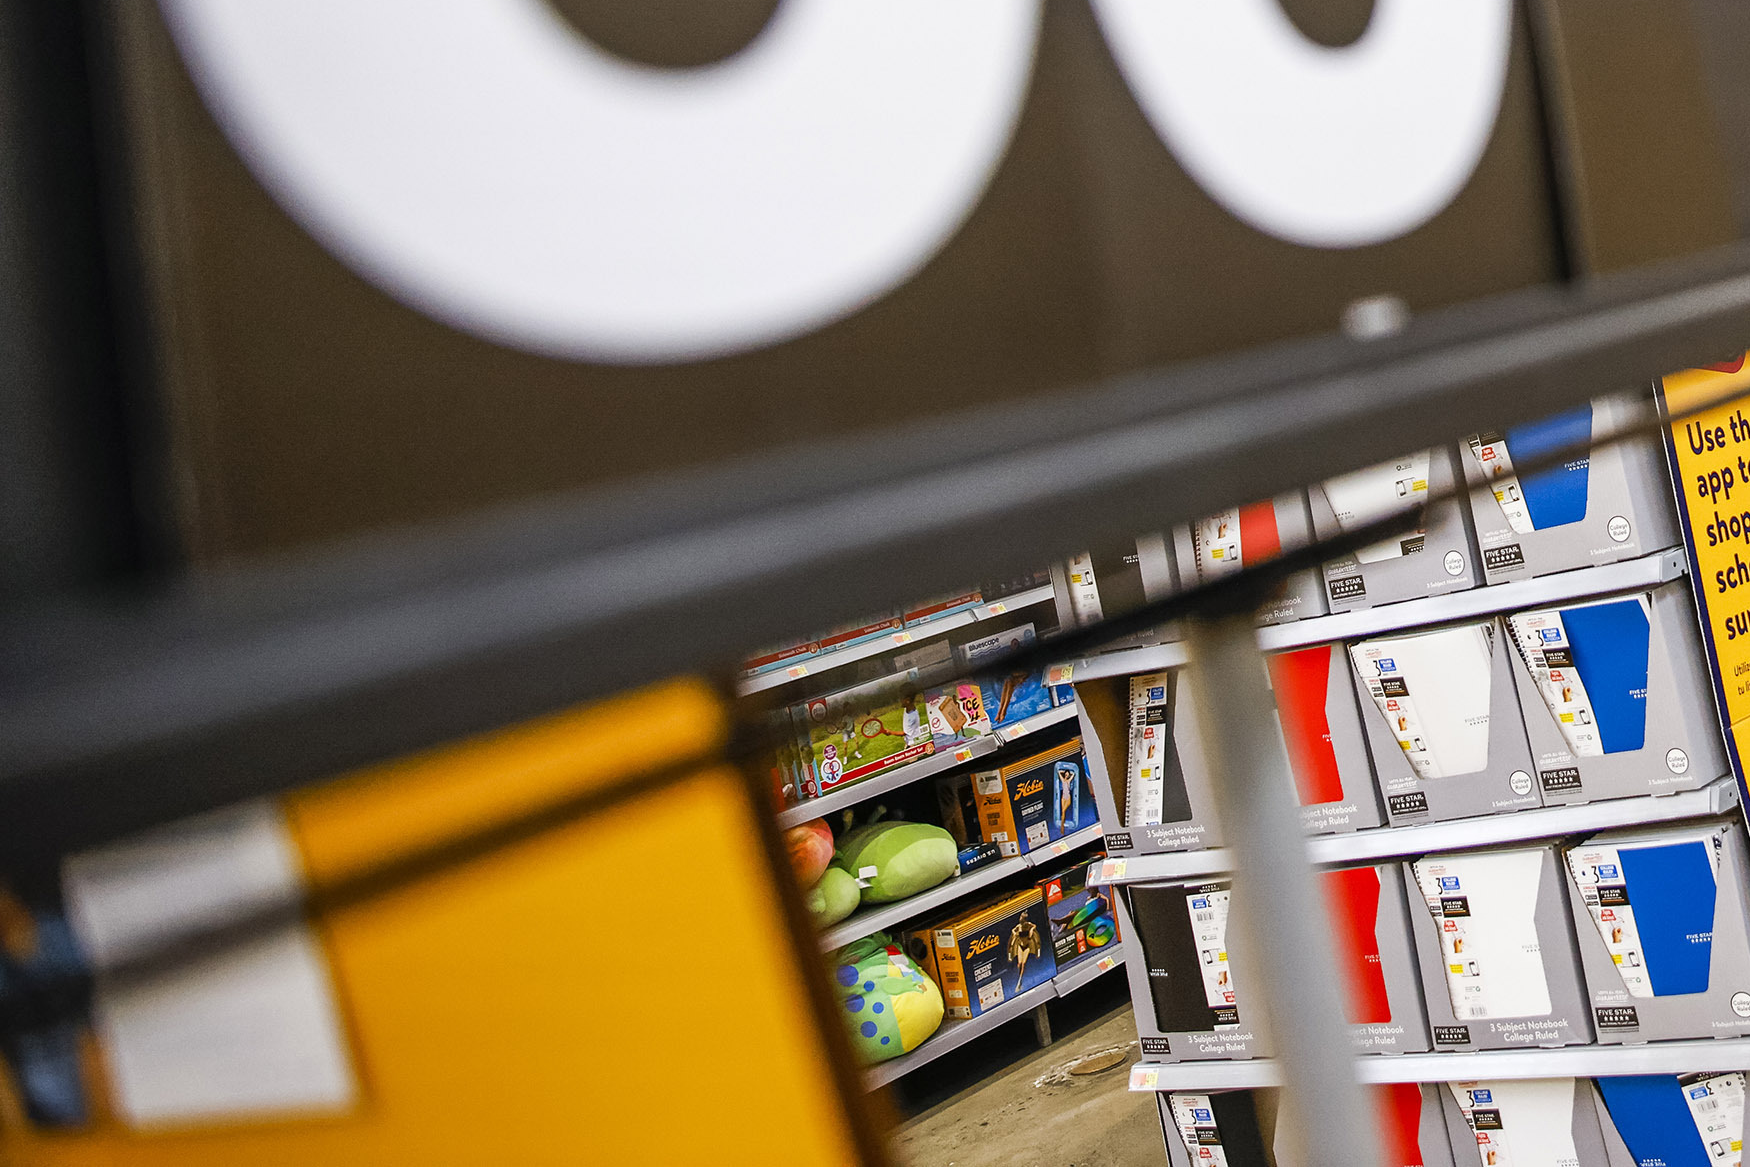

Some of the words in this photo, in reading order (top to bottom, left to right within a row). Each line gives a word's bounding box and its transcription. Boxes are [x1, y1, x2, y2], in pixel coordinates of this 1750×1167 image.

[1686, 422, 1726, 455] Use
[1697, 467, 1734, 504] app
[1486, 549, 1500, 558] FIVE
[1500, 546, 1518, 555] STAR
[1330, 581, 1344, 589] FIVE
[1345, 578, 1361, 586] STAR
[1274, 607, 1294, 618] Ruled
[969, 637, 1000, 652] Bluescape
[1542, 770, 1557, 779] FIVE
[1558, 769, 1576, 777] STAR
[1390, 795, 1405, 804] FIVE
[1405, 794, 1422, 803] STAR
[1322, 804, 1358, 815] Notebook
[1328, 815, 1349, 825] Ruled
[1151, 826, 1173, 839] Subject
[1174, 825, 1205, 836] Notebook
[1106, 835, 1117, 843] FIVE
[1157, 836, 1182, 847] College
[1182, 835, 1200, 845] Ruled
[966, 934, 1000, 960] Hobie
[1490, 1023, 1495, 1032] 3
[1496, 1022, 1527, 1033] Subject
[1528, 1018, 1569, 1030] Notebook
[1367, 1026, 1404, 1037] Notebook
[1504, 1032, 1534, 1042] College
[1535, 1030, 1559, 1040] Ruled
[1193, 1033, 1218, 1045] Subject
[1219, 1032, 1254, 1043] Notebook
[1373, 1035, 1396, 1046] Ruled
[1199, 1043, 1224, 1053] College
[1224, 1042, 1246, 1051] Ruled
